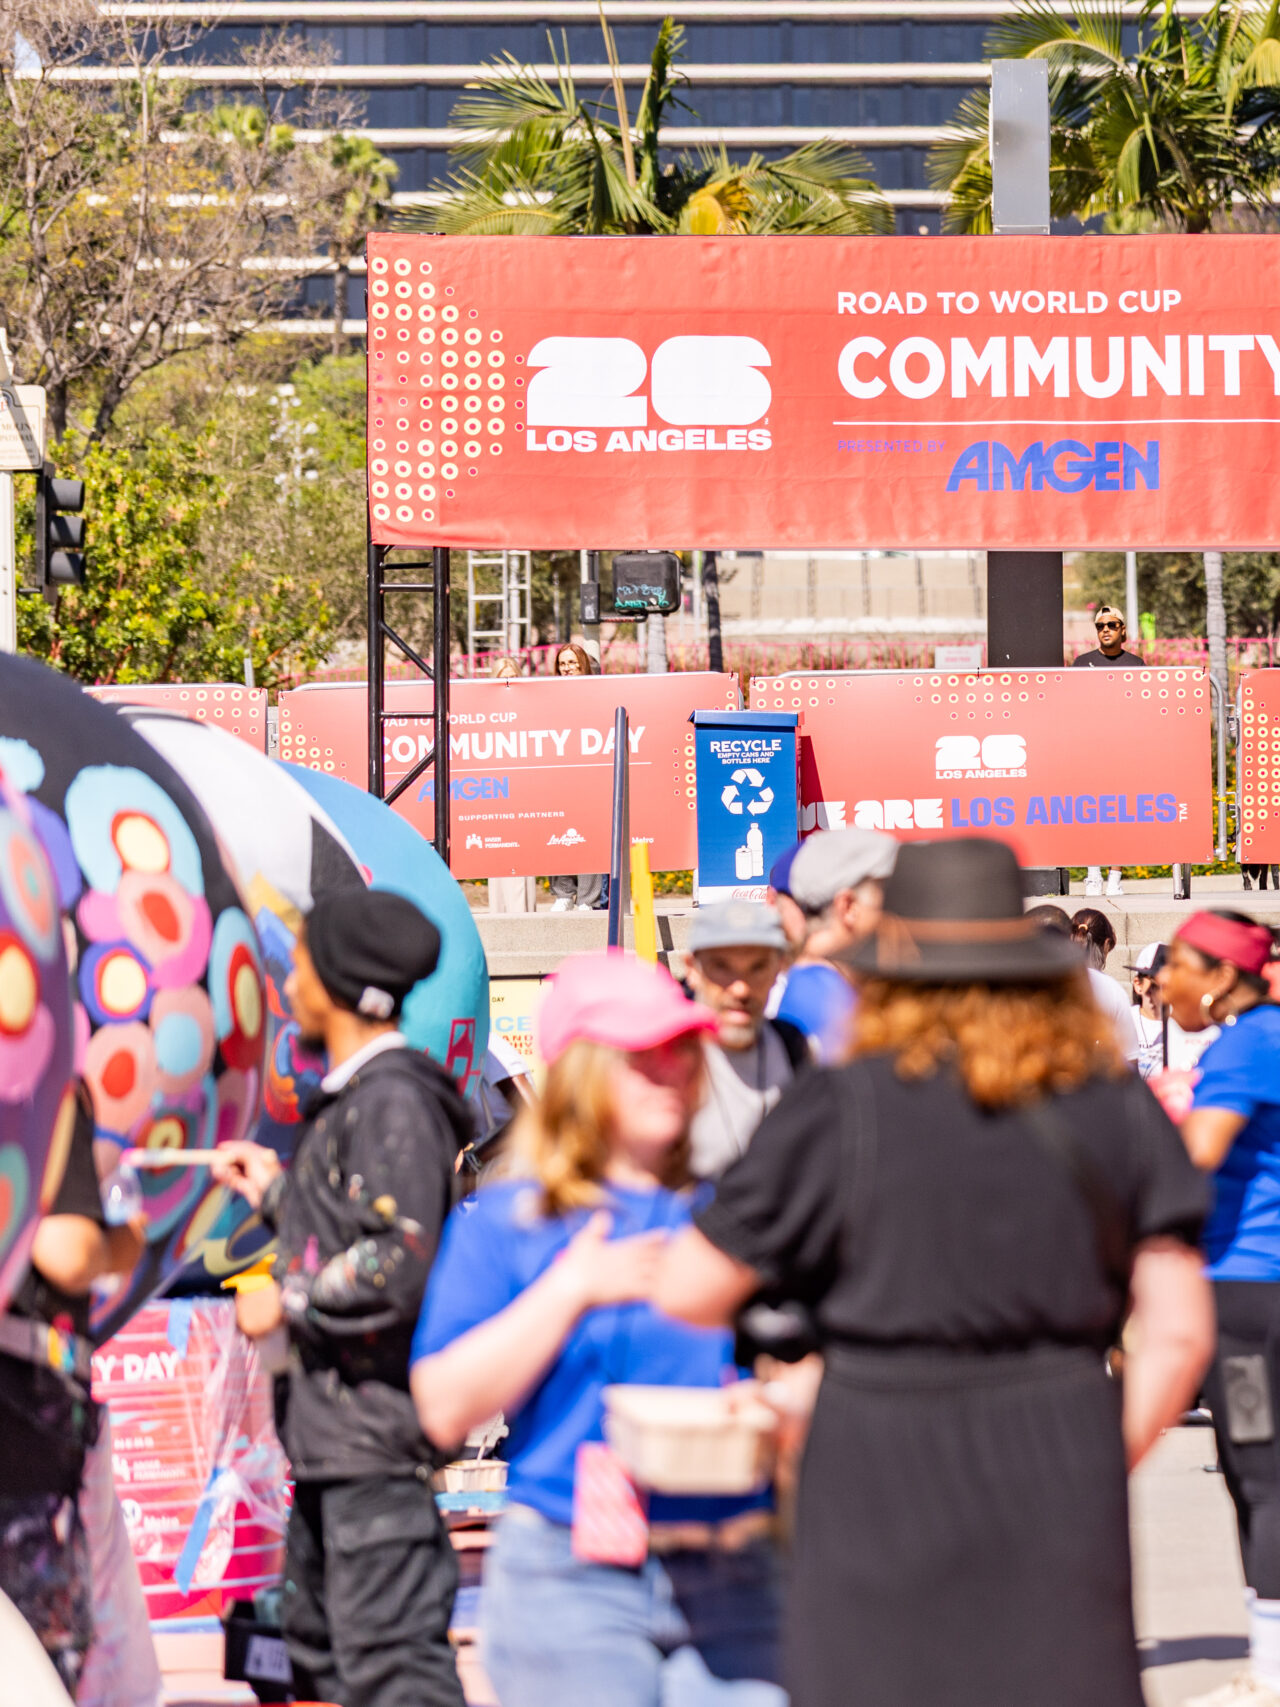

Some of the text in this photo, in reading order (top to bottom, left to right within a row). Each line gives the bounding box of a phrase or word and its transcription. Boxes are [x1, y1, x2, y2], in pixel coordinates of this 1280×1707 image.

[838, 289, 1182, 314] ROAD TO WORLD CUP
[526, 335, 772, 427] 26
[526, 428, 773, 453] LOS ANGELES
[837, 440, 947, 453] PRESENTED BY
[945, 439, 1160, 493] AMGEN
[448, 713, 486, 725] ORLD
[490, 711, 518, 723] CUP
[710, 739, 782, 753] RECYCLE
[935, 734, 1027, 769] 26
[721, 757, 752, 765] BOTTLES
[935, 769, 1027, 780] LOS ANGELES
[458, 810, 565, 822] SUPPORTING PARTNERS
[951, 797, 1016, 828] LOS
[1025, 793, 1178, 825] ANGELES
[123, 1351, 179, 1382] DAY
